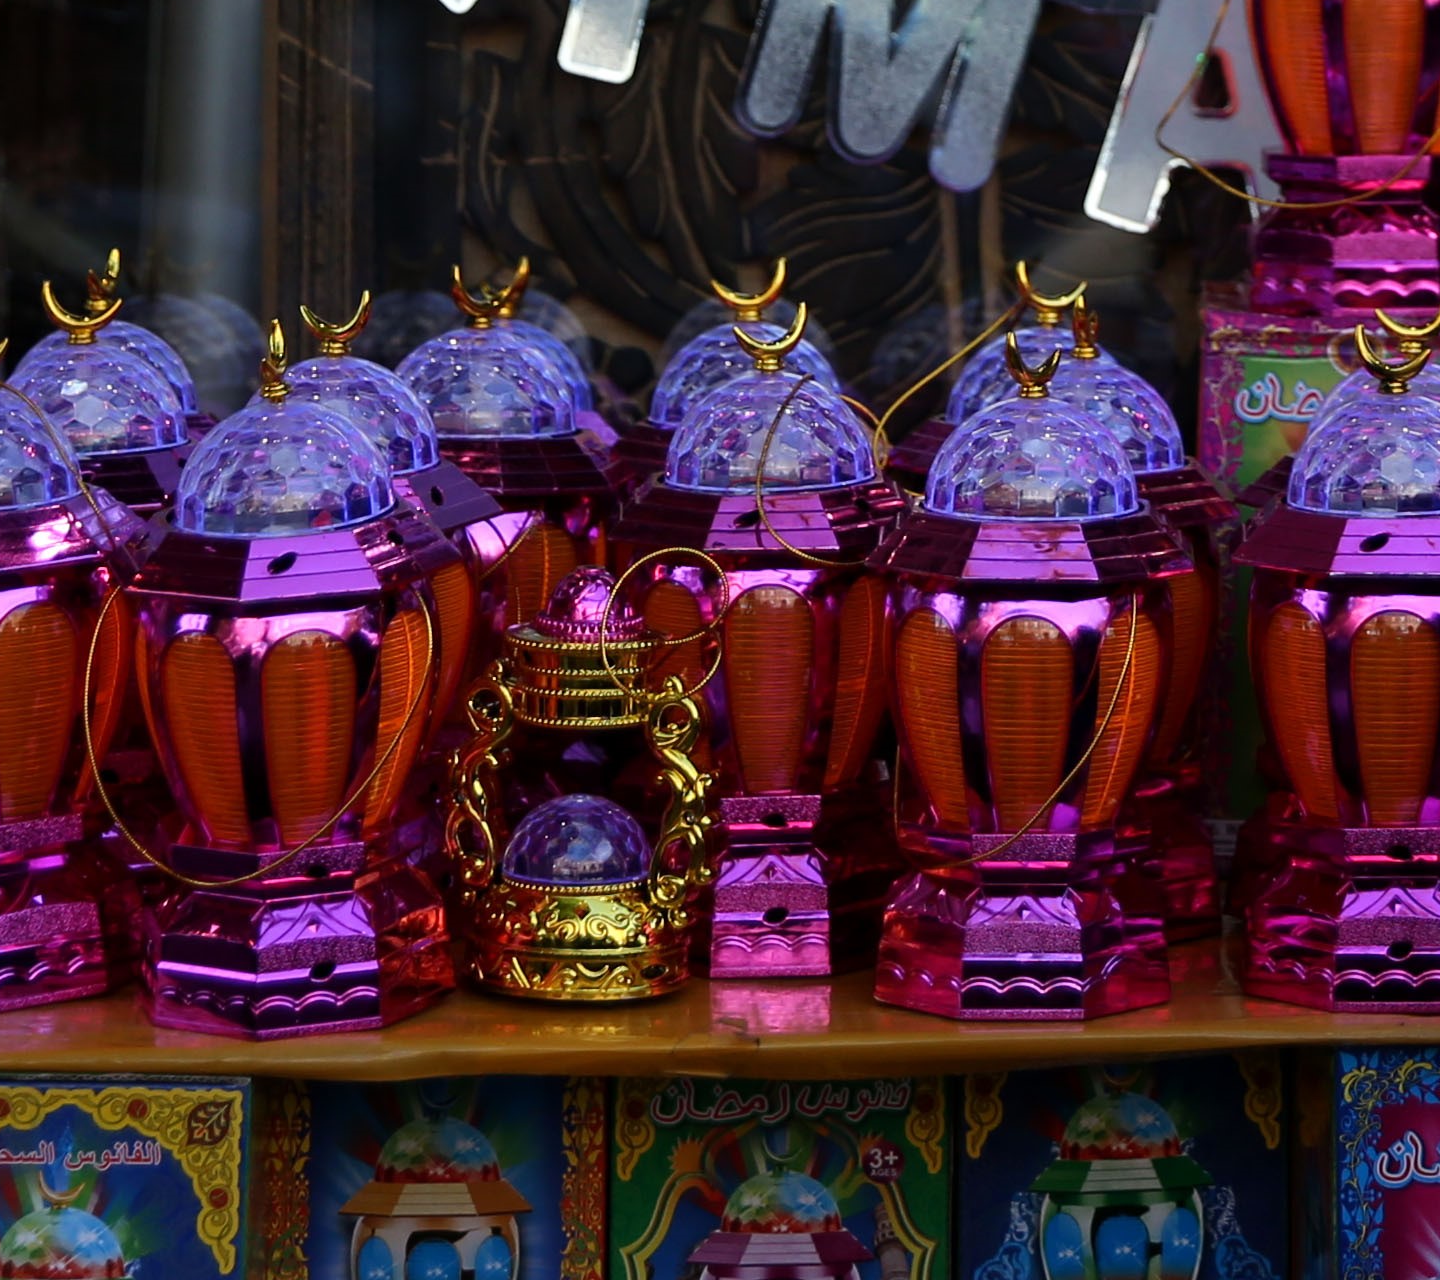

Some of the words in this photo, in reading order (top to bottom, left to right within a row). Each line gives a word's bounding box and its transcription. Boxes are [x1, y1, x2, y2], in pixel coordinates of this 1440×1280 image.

[650, 1078, 792, 1125] رمضان
[63, 1140, 162, 1171] الفانوس
[869, 1148, 899, 1168] 3+
